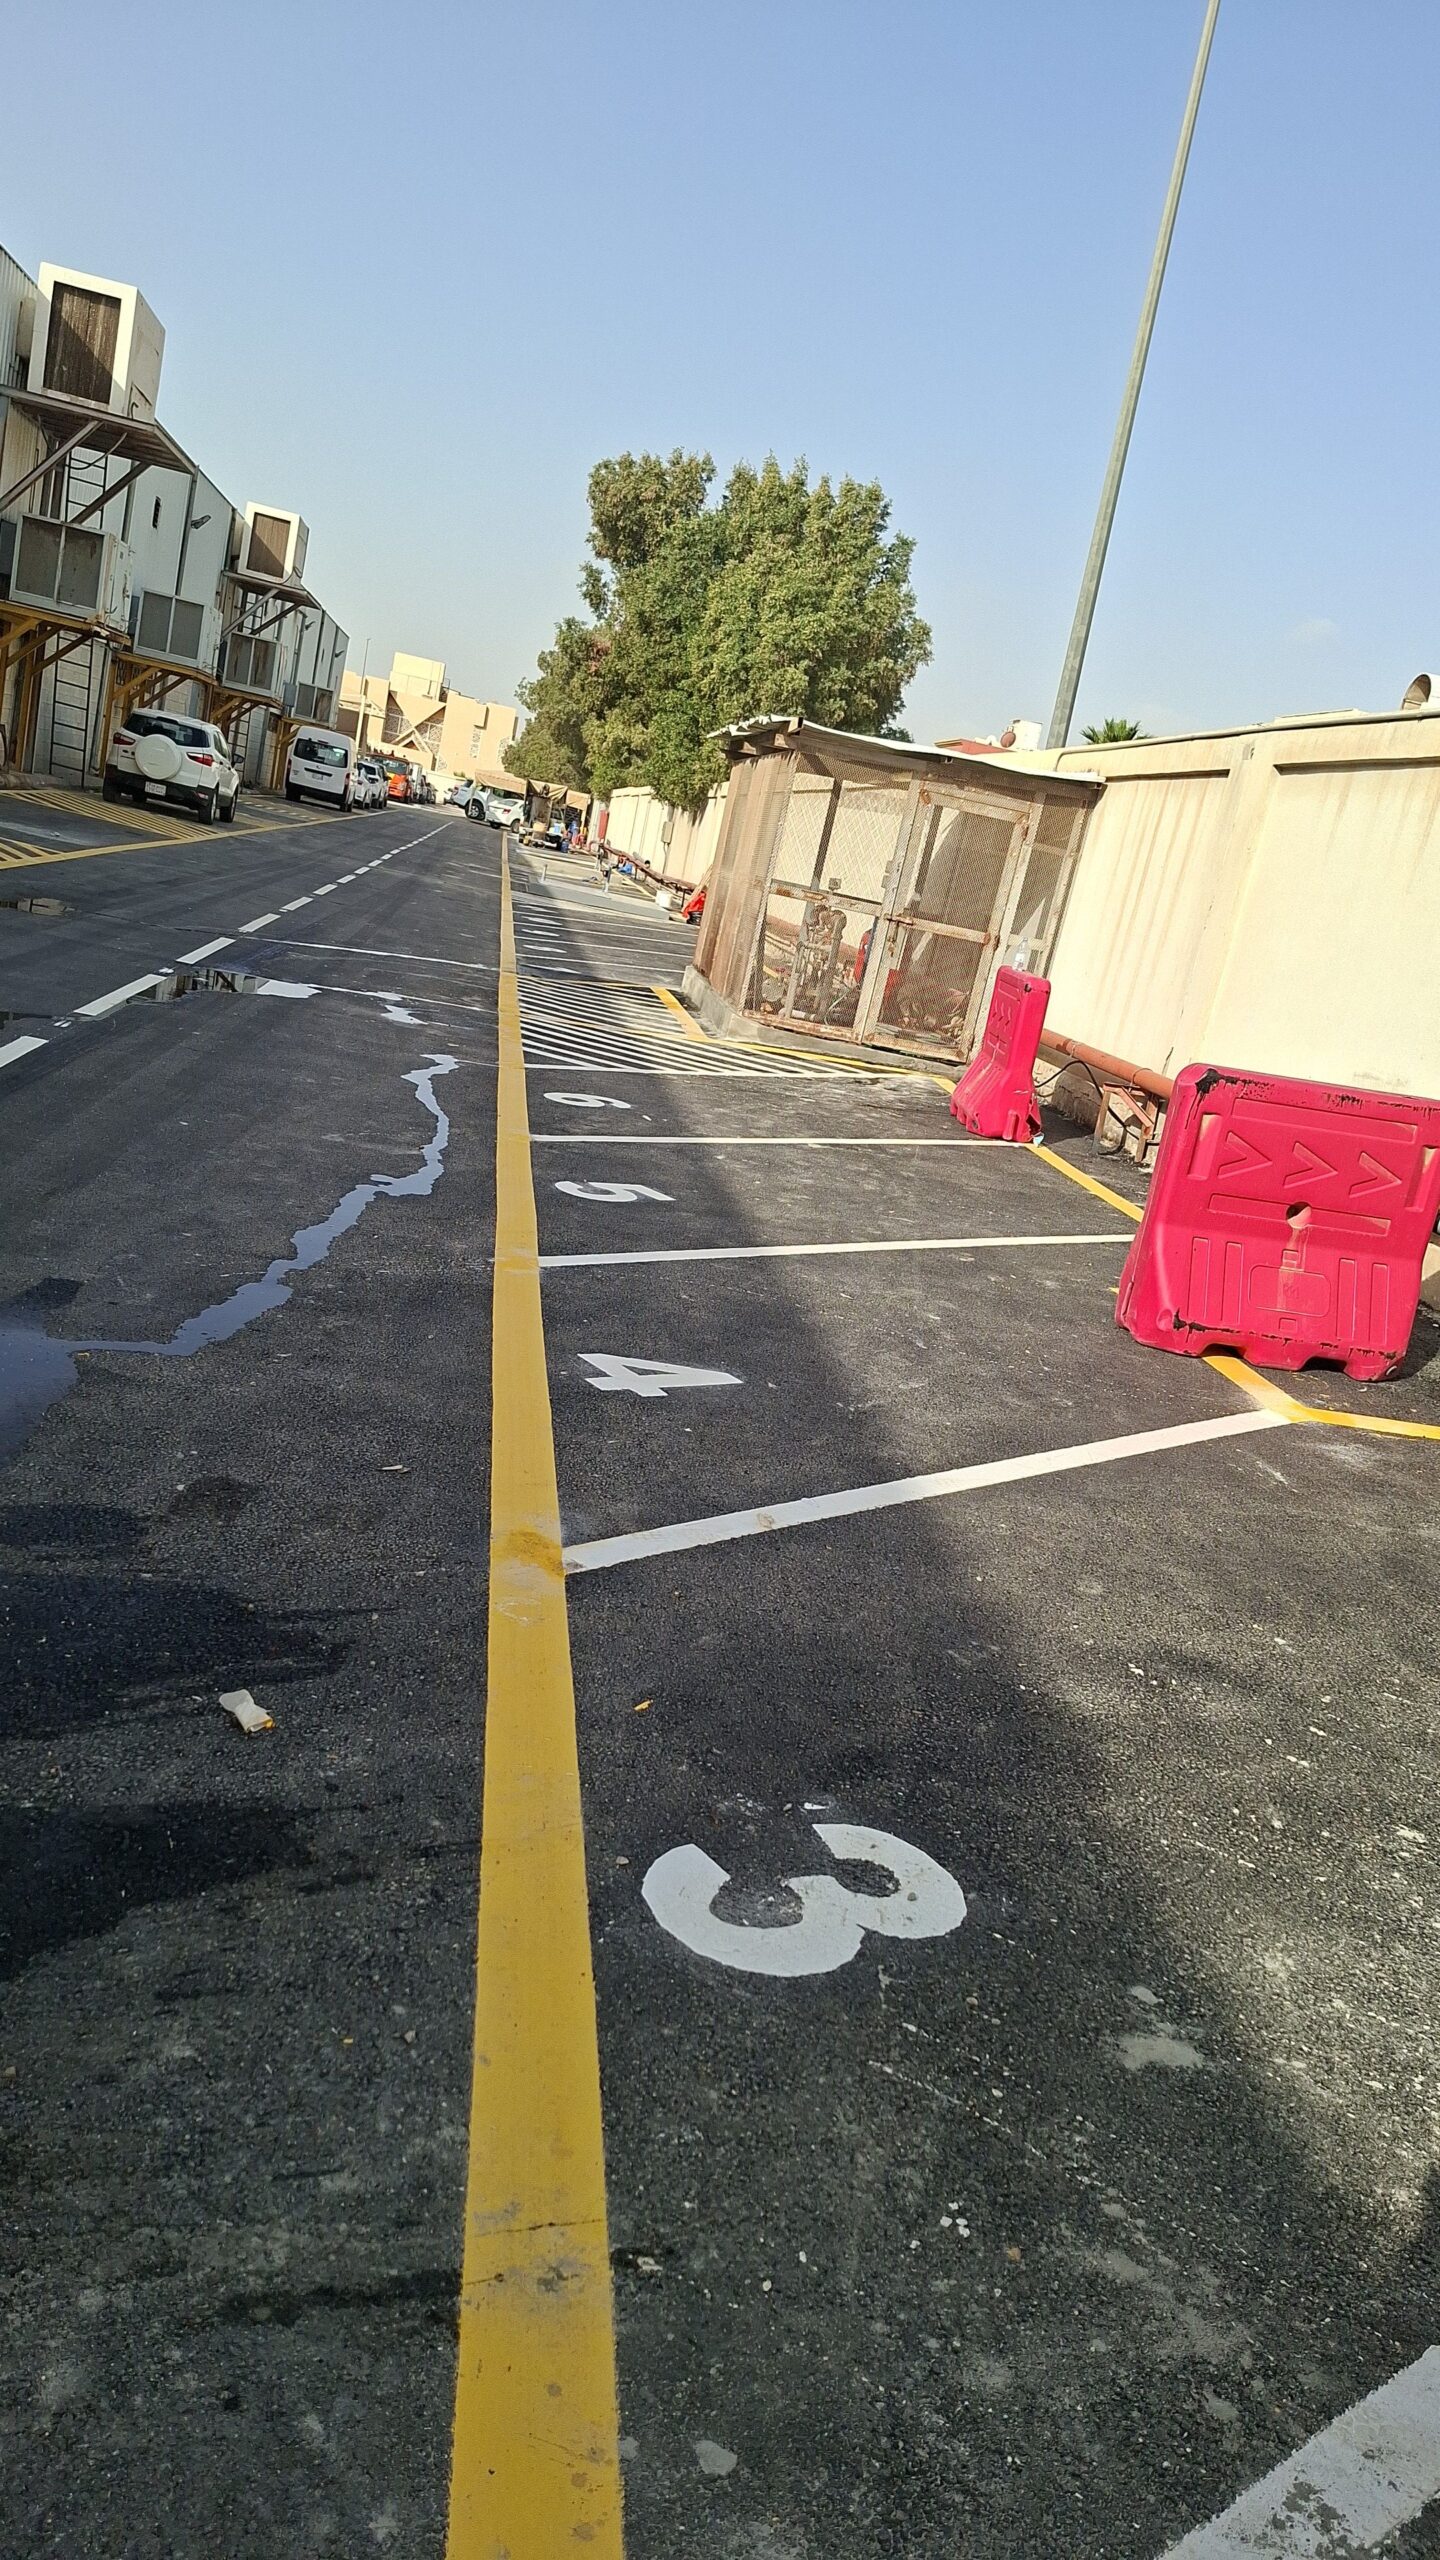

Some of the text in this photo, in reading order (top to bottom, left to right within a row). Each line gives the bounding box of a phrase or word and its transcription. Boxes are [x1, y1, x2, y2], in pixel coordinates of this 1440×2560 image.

[555, 1180, 676, 1203] 5
[577, 1353, 744, 1398] 4
[641, 1822, 968, 1978] 3
